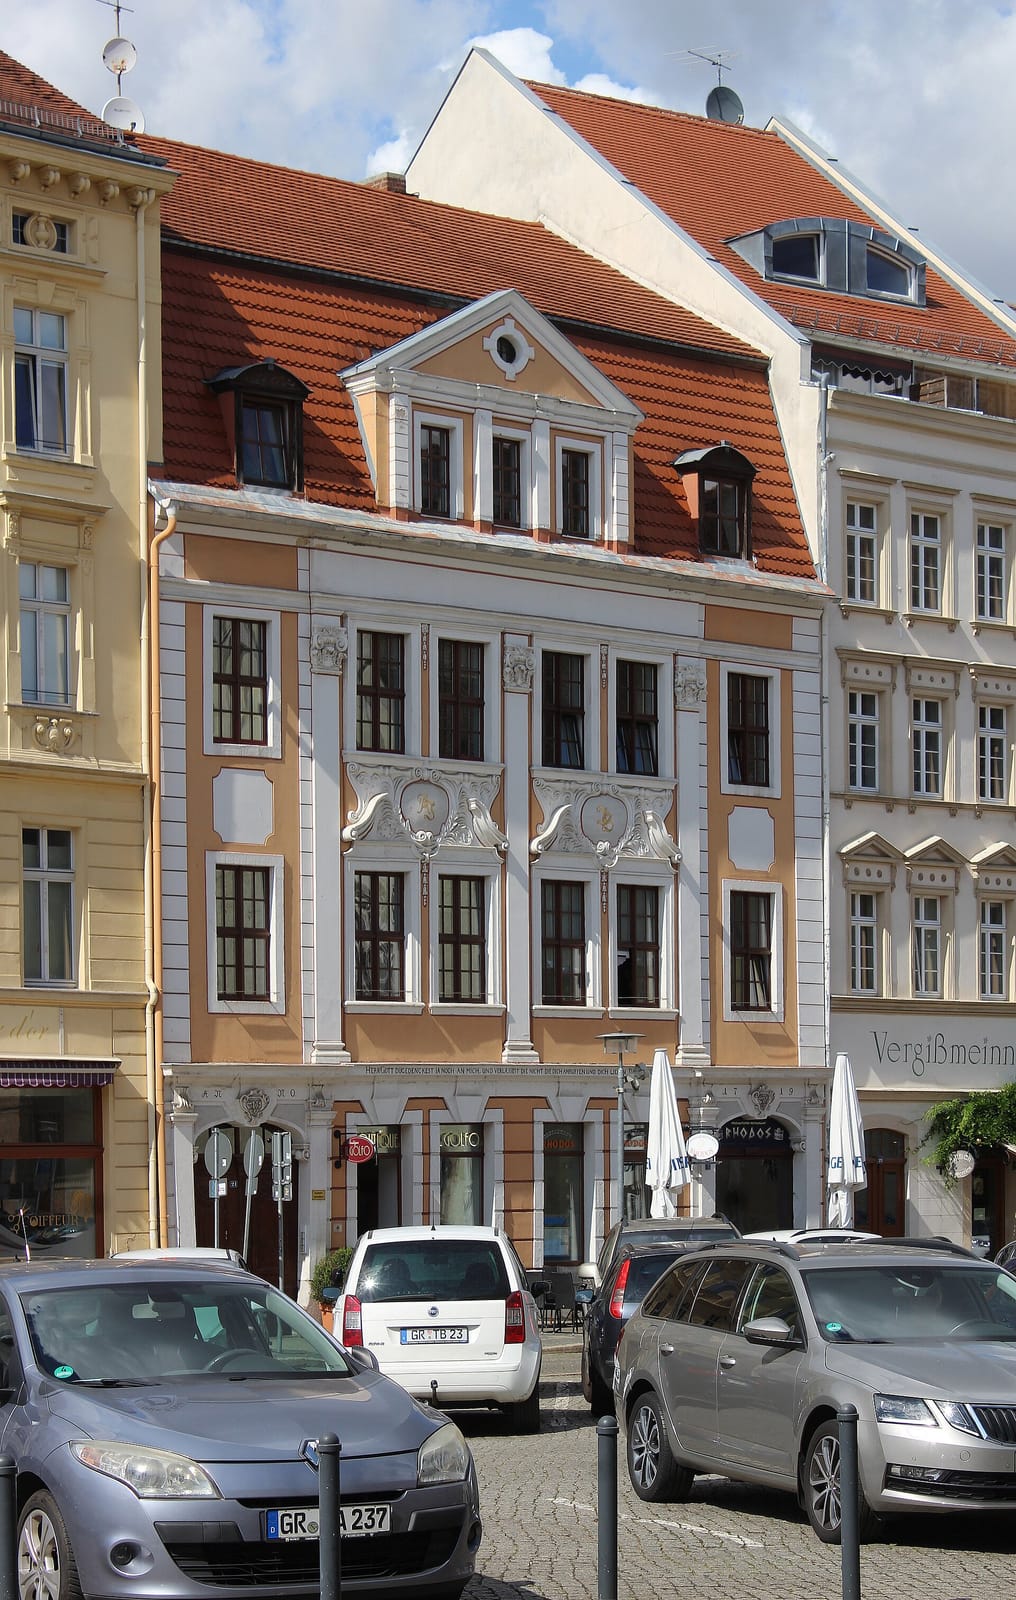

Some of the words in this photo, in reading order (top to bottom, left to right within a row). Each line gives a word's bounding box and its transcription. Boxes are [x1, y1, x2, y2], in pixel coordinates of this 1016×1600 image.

[869, 1031, 1015, 1077] Vergißmeinn
[411, 1329, 425, 1340] GR
[432, 1329, 447, 1340] TB
[449, 1328, 463, 1339] 23
[280, 1512, 307, 1534] GR
[351, 1507, 388, 1531] 237
